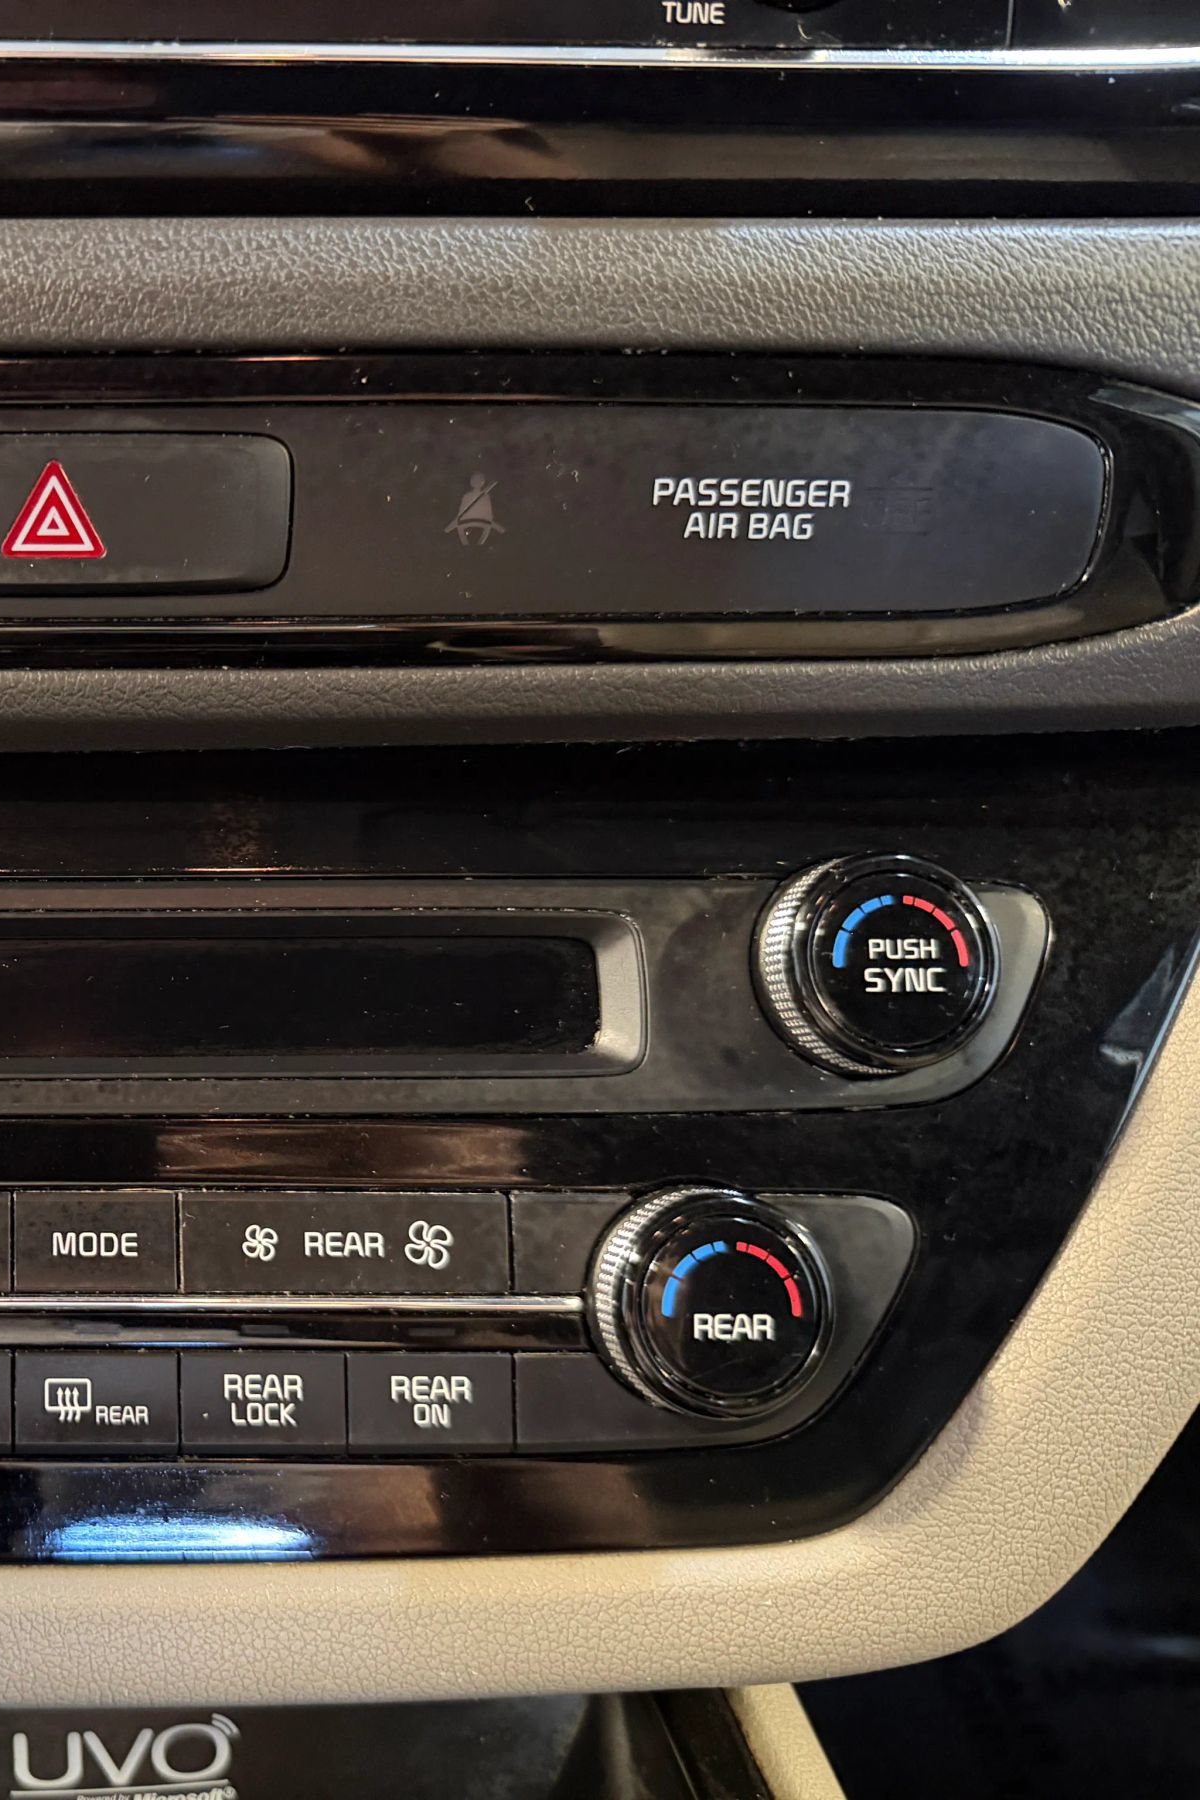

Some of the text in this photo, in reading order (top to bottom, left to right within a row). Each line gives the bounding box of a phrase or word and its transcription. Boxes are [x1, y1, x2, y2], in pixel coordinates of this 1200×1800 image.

[662, 1, 725, 25] TUNE
[652, 478, 851, 508] PASSENGER
[683, 512, 813, 540] AIR BAG
[868, 938, 938, 960] PUSH
[863, 967, 946, 993] SYNC
[52, 1231, 138, 1257] MODE
[304, 1231, 385, 1258] REAR
[693, 1313, 776, 1341] REAR
[223, 1373, 304, 1401] REAR
[390, 1375, 473, 1402] REAR
[96, 1405, 149, 1425] REAR
[231, 1402, 297, 1428] LOCK
[413, 1403, 450, 1429] ON
[12, 1722, 233, 1791] UVO
